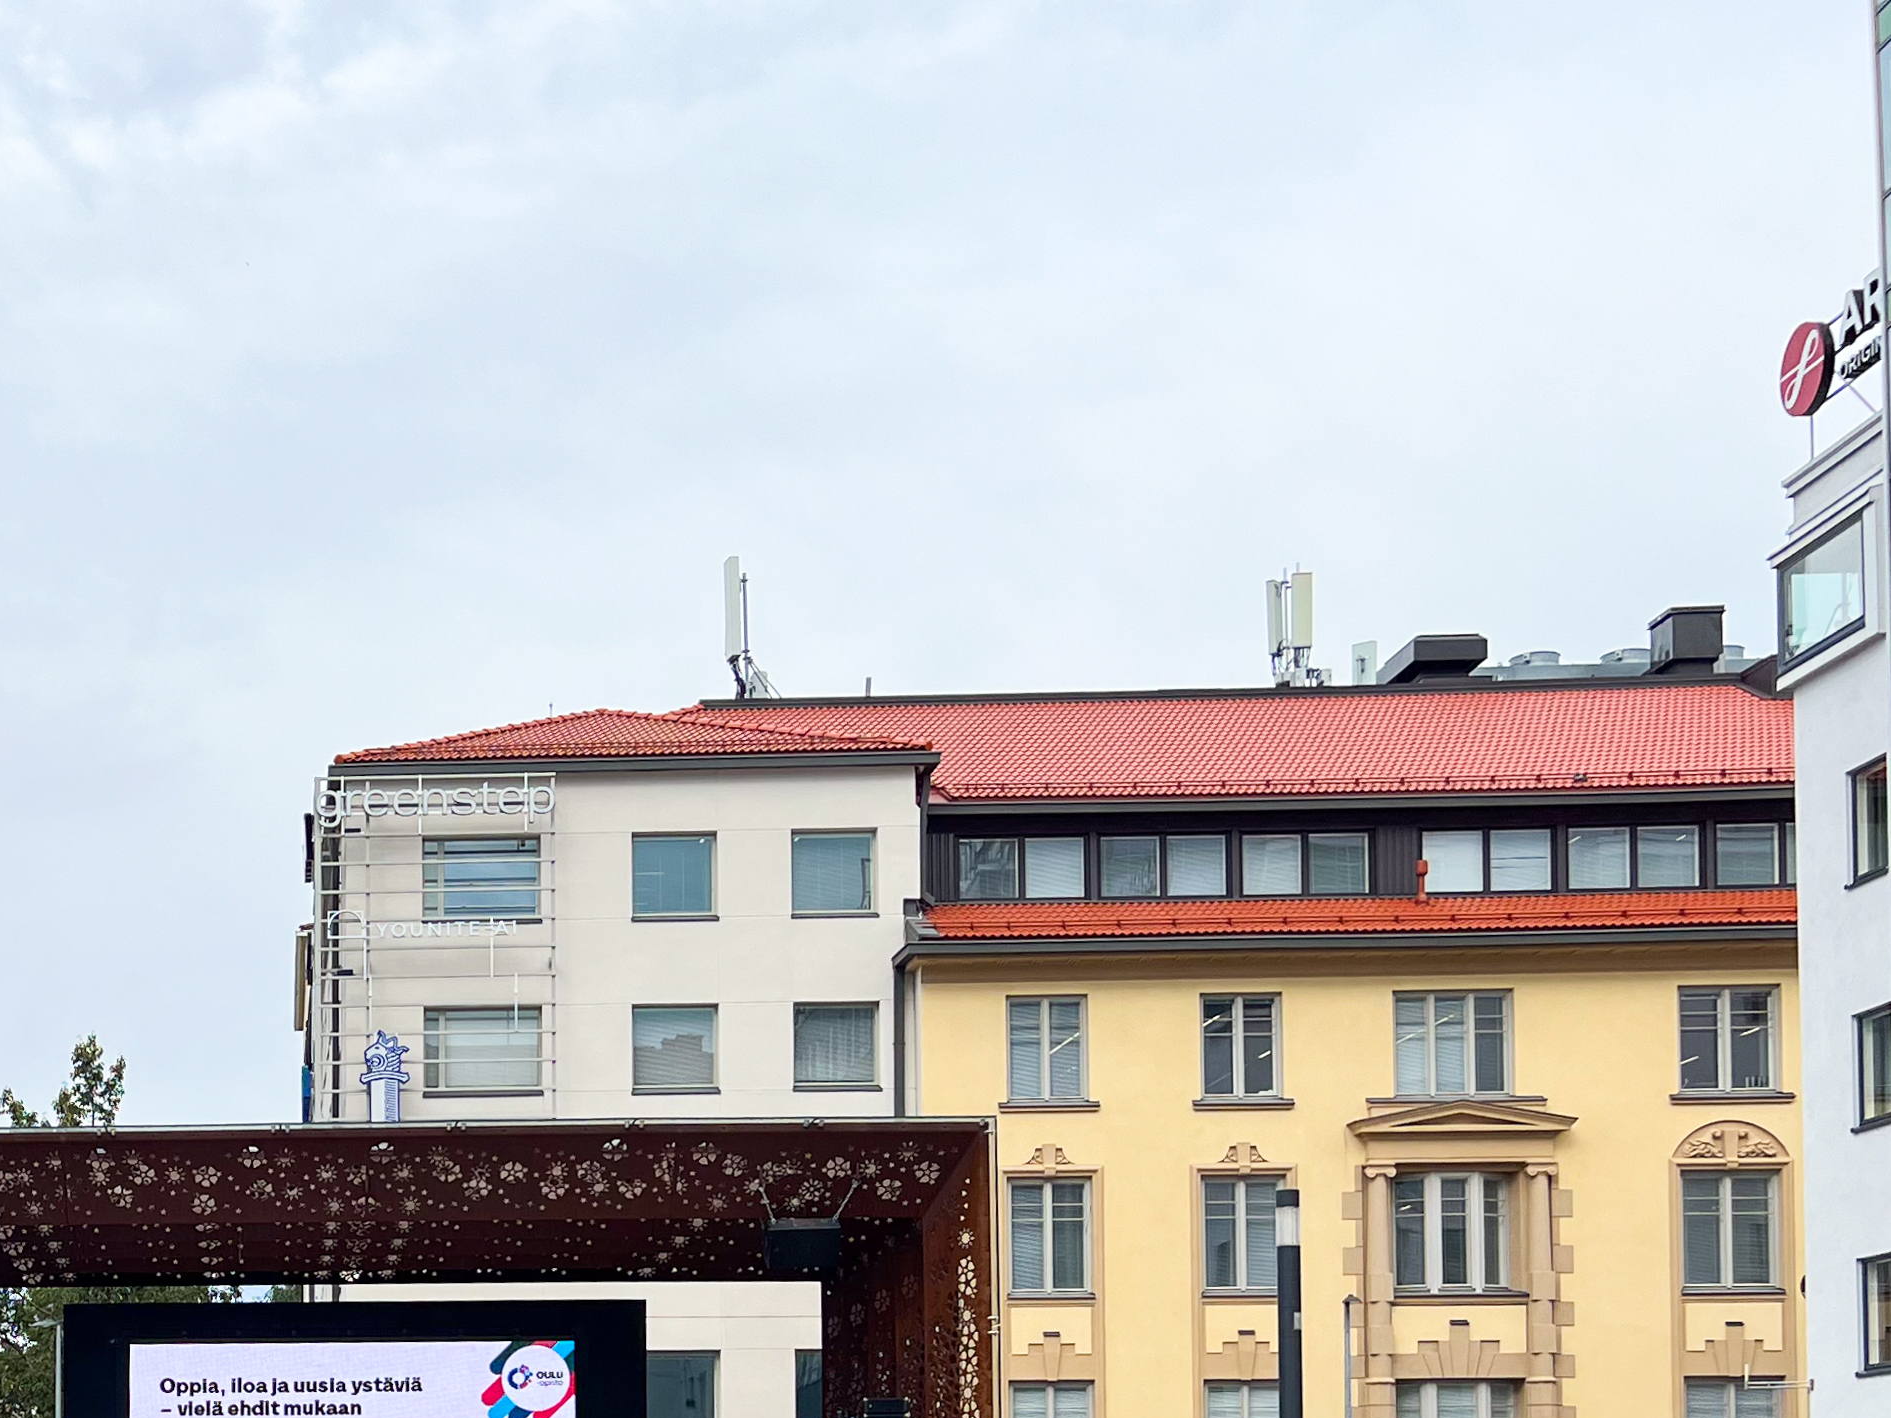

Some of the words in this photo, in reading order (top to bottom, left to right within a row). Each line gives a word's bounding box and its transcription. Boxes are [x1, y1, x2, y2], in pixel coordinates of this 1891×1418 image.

[315, 781, 556, 827] greenstep
[159, 1378, 225, 1397] Oppia,
[231, 1377, 268, 1393] iloa
[271, 1377, 289, 1396] ja
[294, 1377, 347, 1393] uusia
[351, 1377, 423, 1395] ystäviä
[177, 1400, 224, 1416] vielä
[228, 1400, 280, 1416] ehdit
[283, 1399, 362, 1416] mukaan
